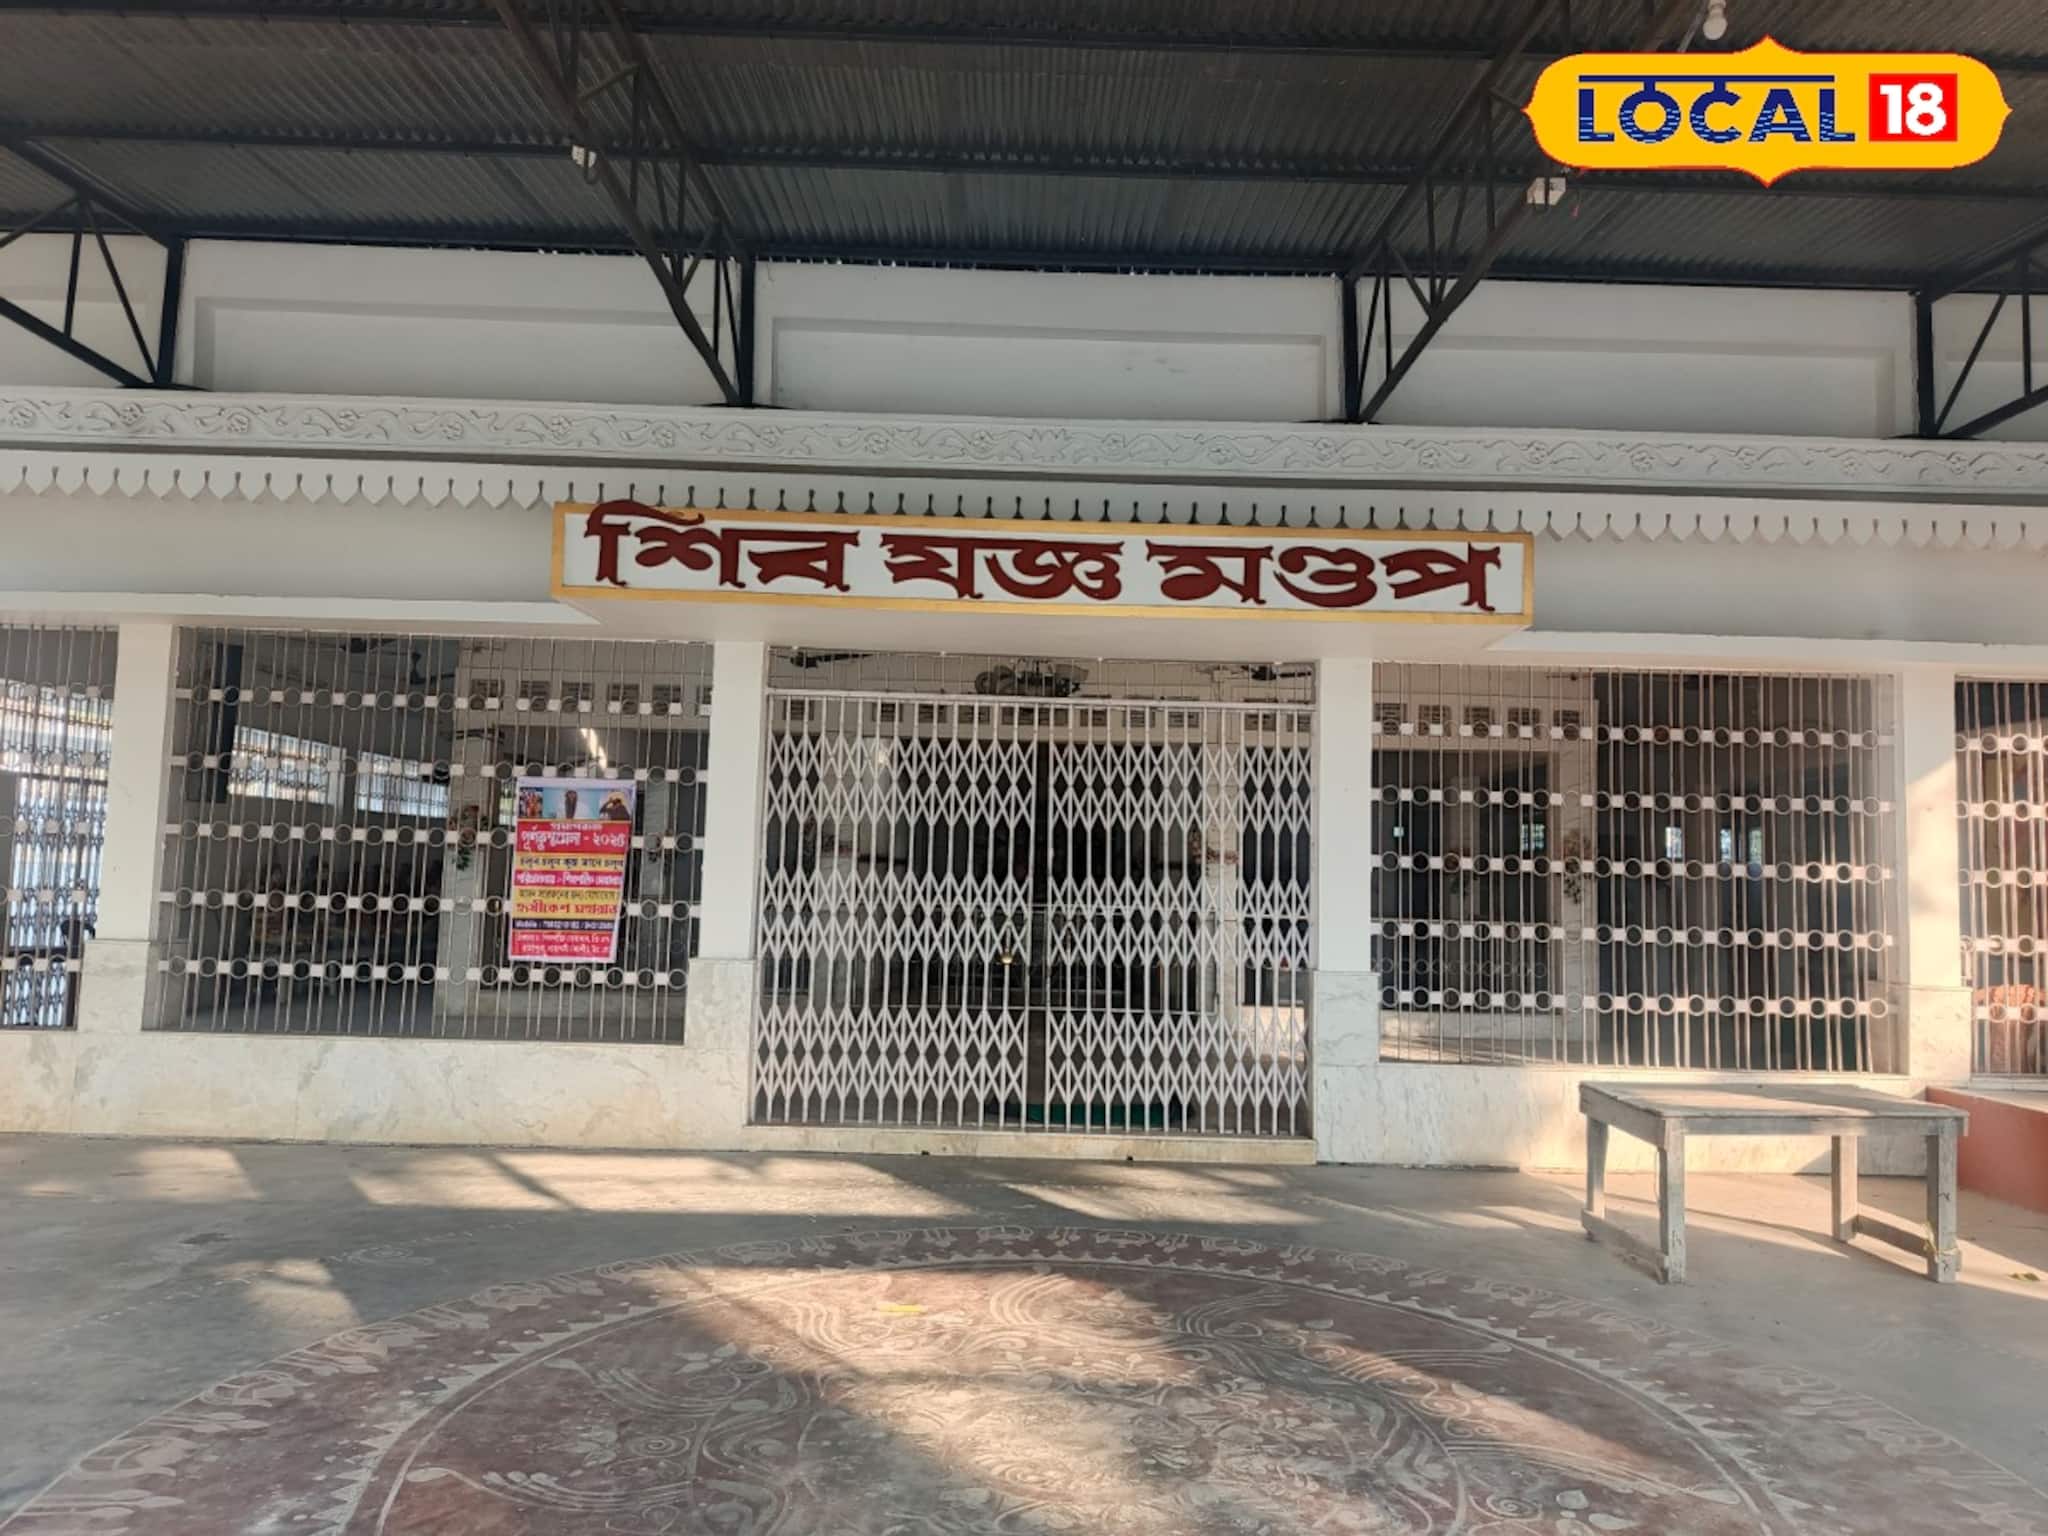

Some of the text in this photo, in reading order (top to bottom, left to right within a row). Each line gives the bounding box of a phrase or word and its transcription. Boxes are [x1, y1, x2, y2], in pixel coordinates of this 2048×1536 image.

[584, 499, 1502, 612] শিব যজ্ঞ মণ্ডপ
